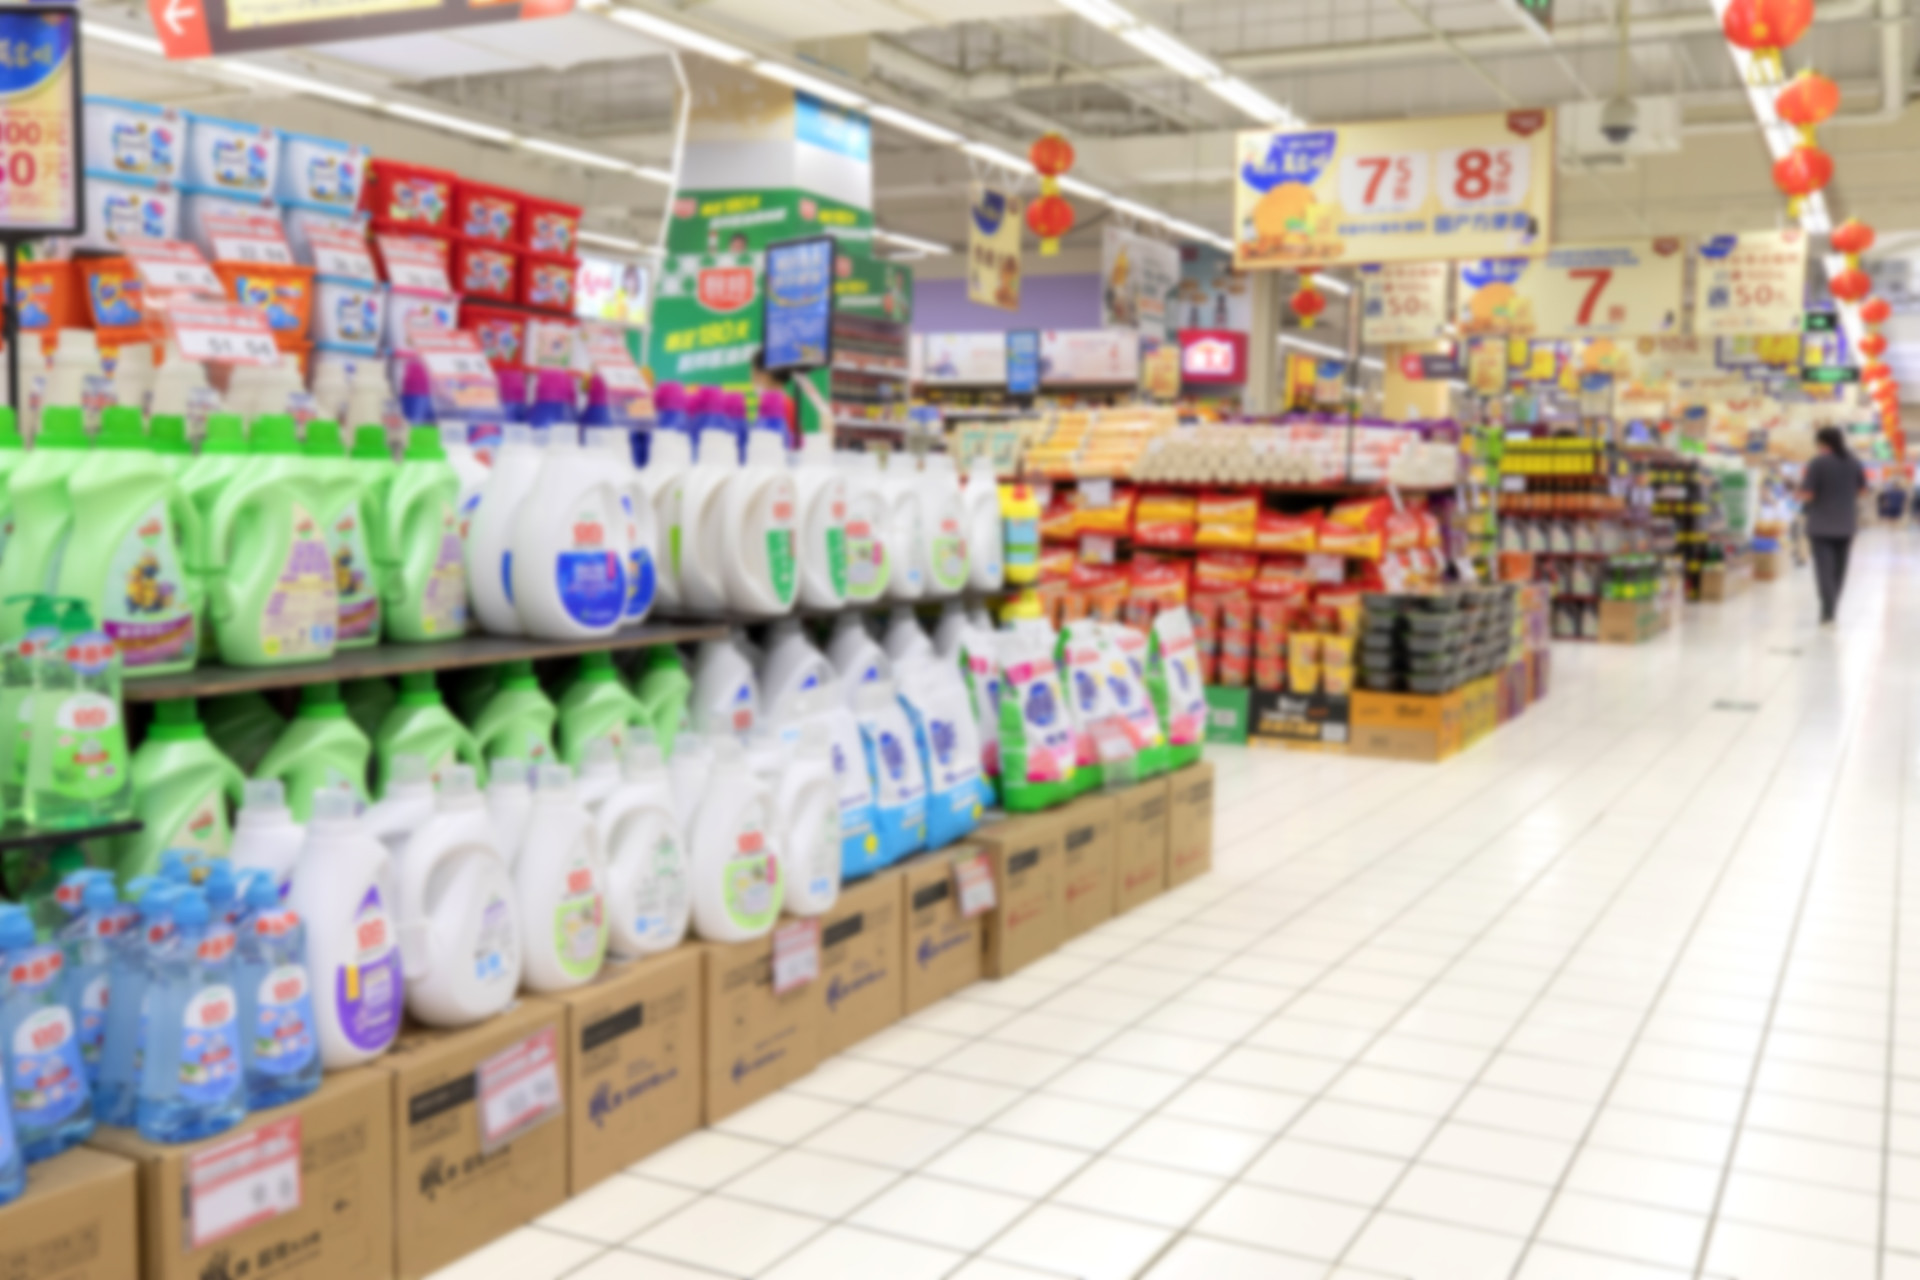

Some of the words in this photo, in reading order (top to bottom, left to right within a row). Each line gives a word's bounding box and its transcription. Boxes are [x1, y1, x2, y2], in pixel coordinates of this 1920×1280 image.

[1356, 157, 1391, 205] 7
[1454, 148, 1492, 200] 8
[1568, 268, 1613, 326] 7
